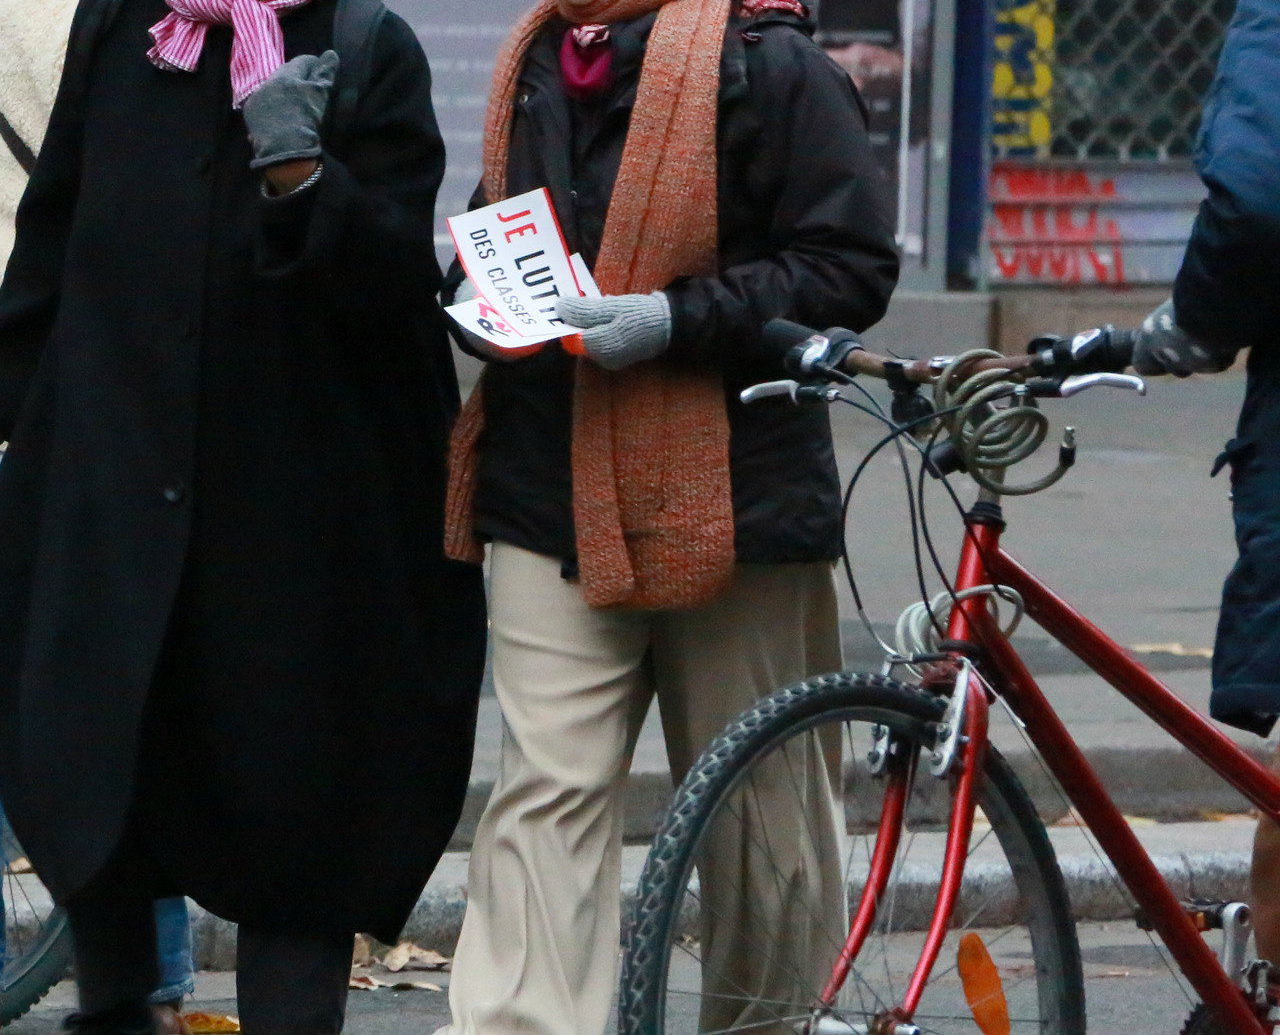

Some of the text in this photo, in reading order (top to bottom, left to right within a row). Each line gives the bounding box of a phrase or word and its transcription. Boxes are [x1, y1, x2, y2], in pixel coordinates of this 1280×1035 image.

[496, 209, 538, 244] JE
[469, 228, 496, 260] DES
[487, 267, 538, 326] CLASSES
